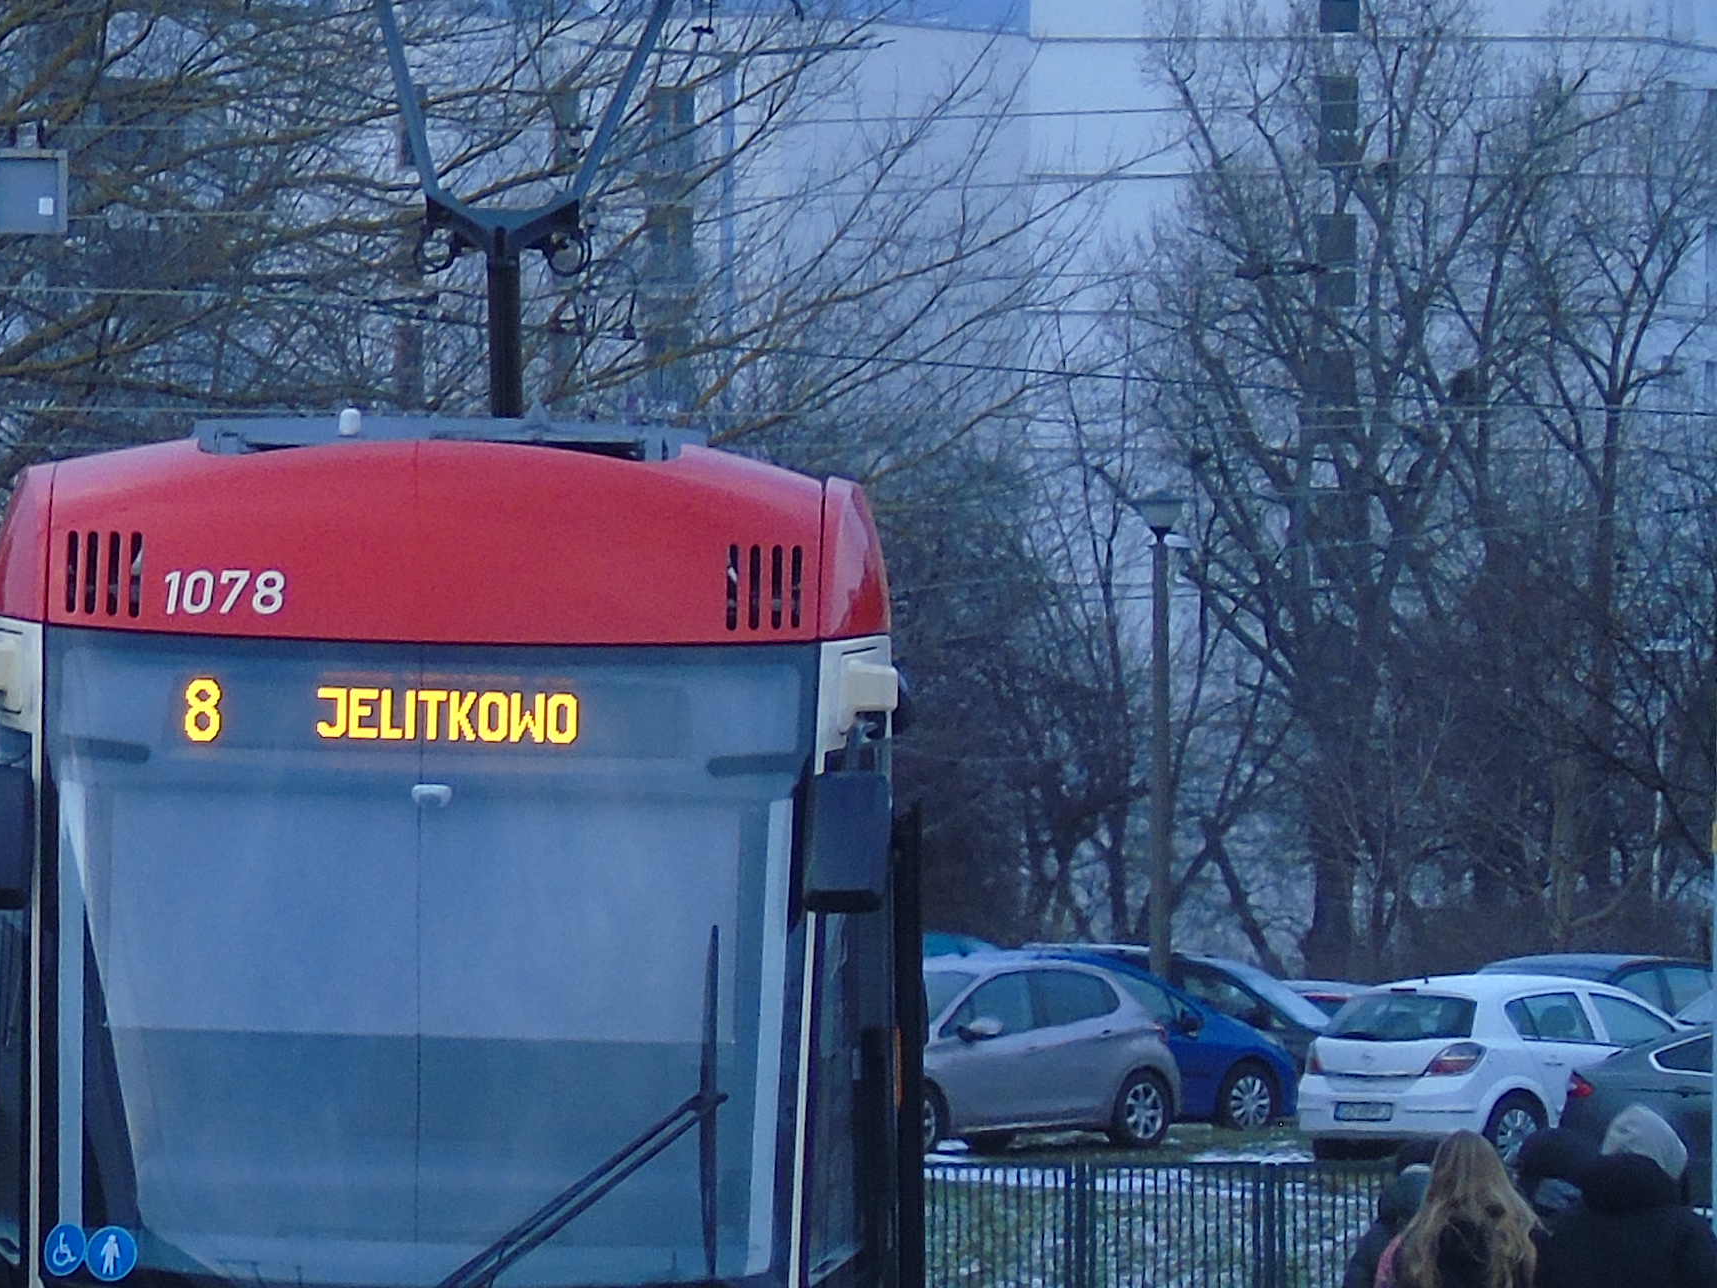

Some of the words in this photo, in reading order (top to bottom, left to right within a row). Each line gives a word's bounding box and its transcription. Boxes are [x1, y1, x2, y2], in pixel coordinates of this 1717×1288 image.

[164, 569, 287, 616] 1078
[183, 677, 222, 743] 8
[316, 685, 580, 745] JELITKOWO
